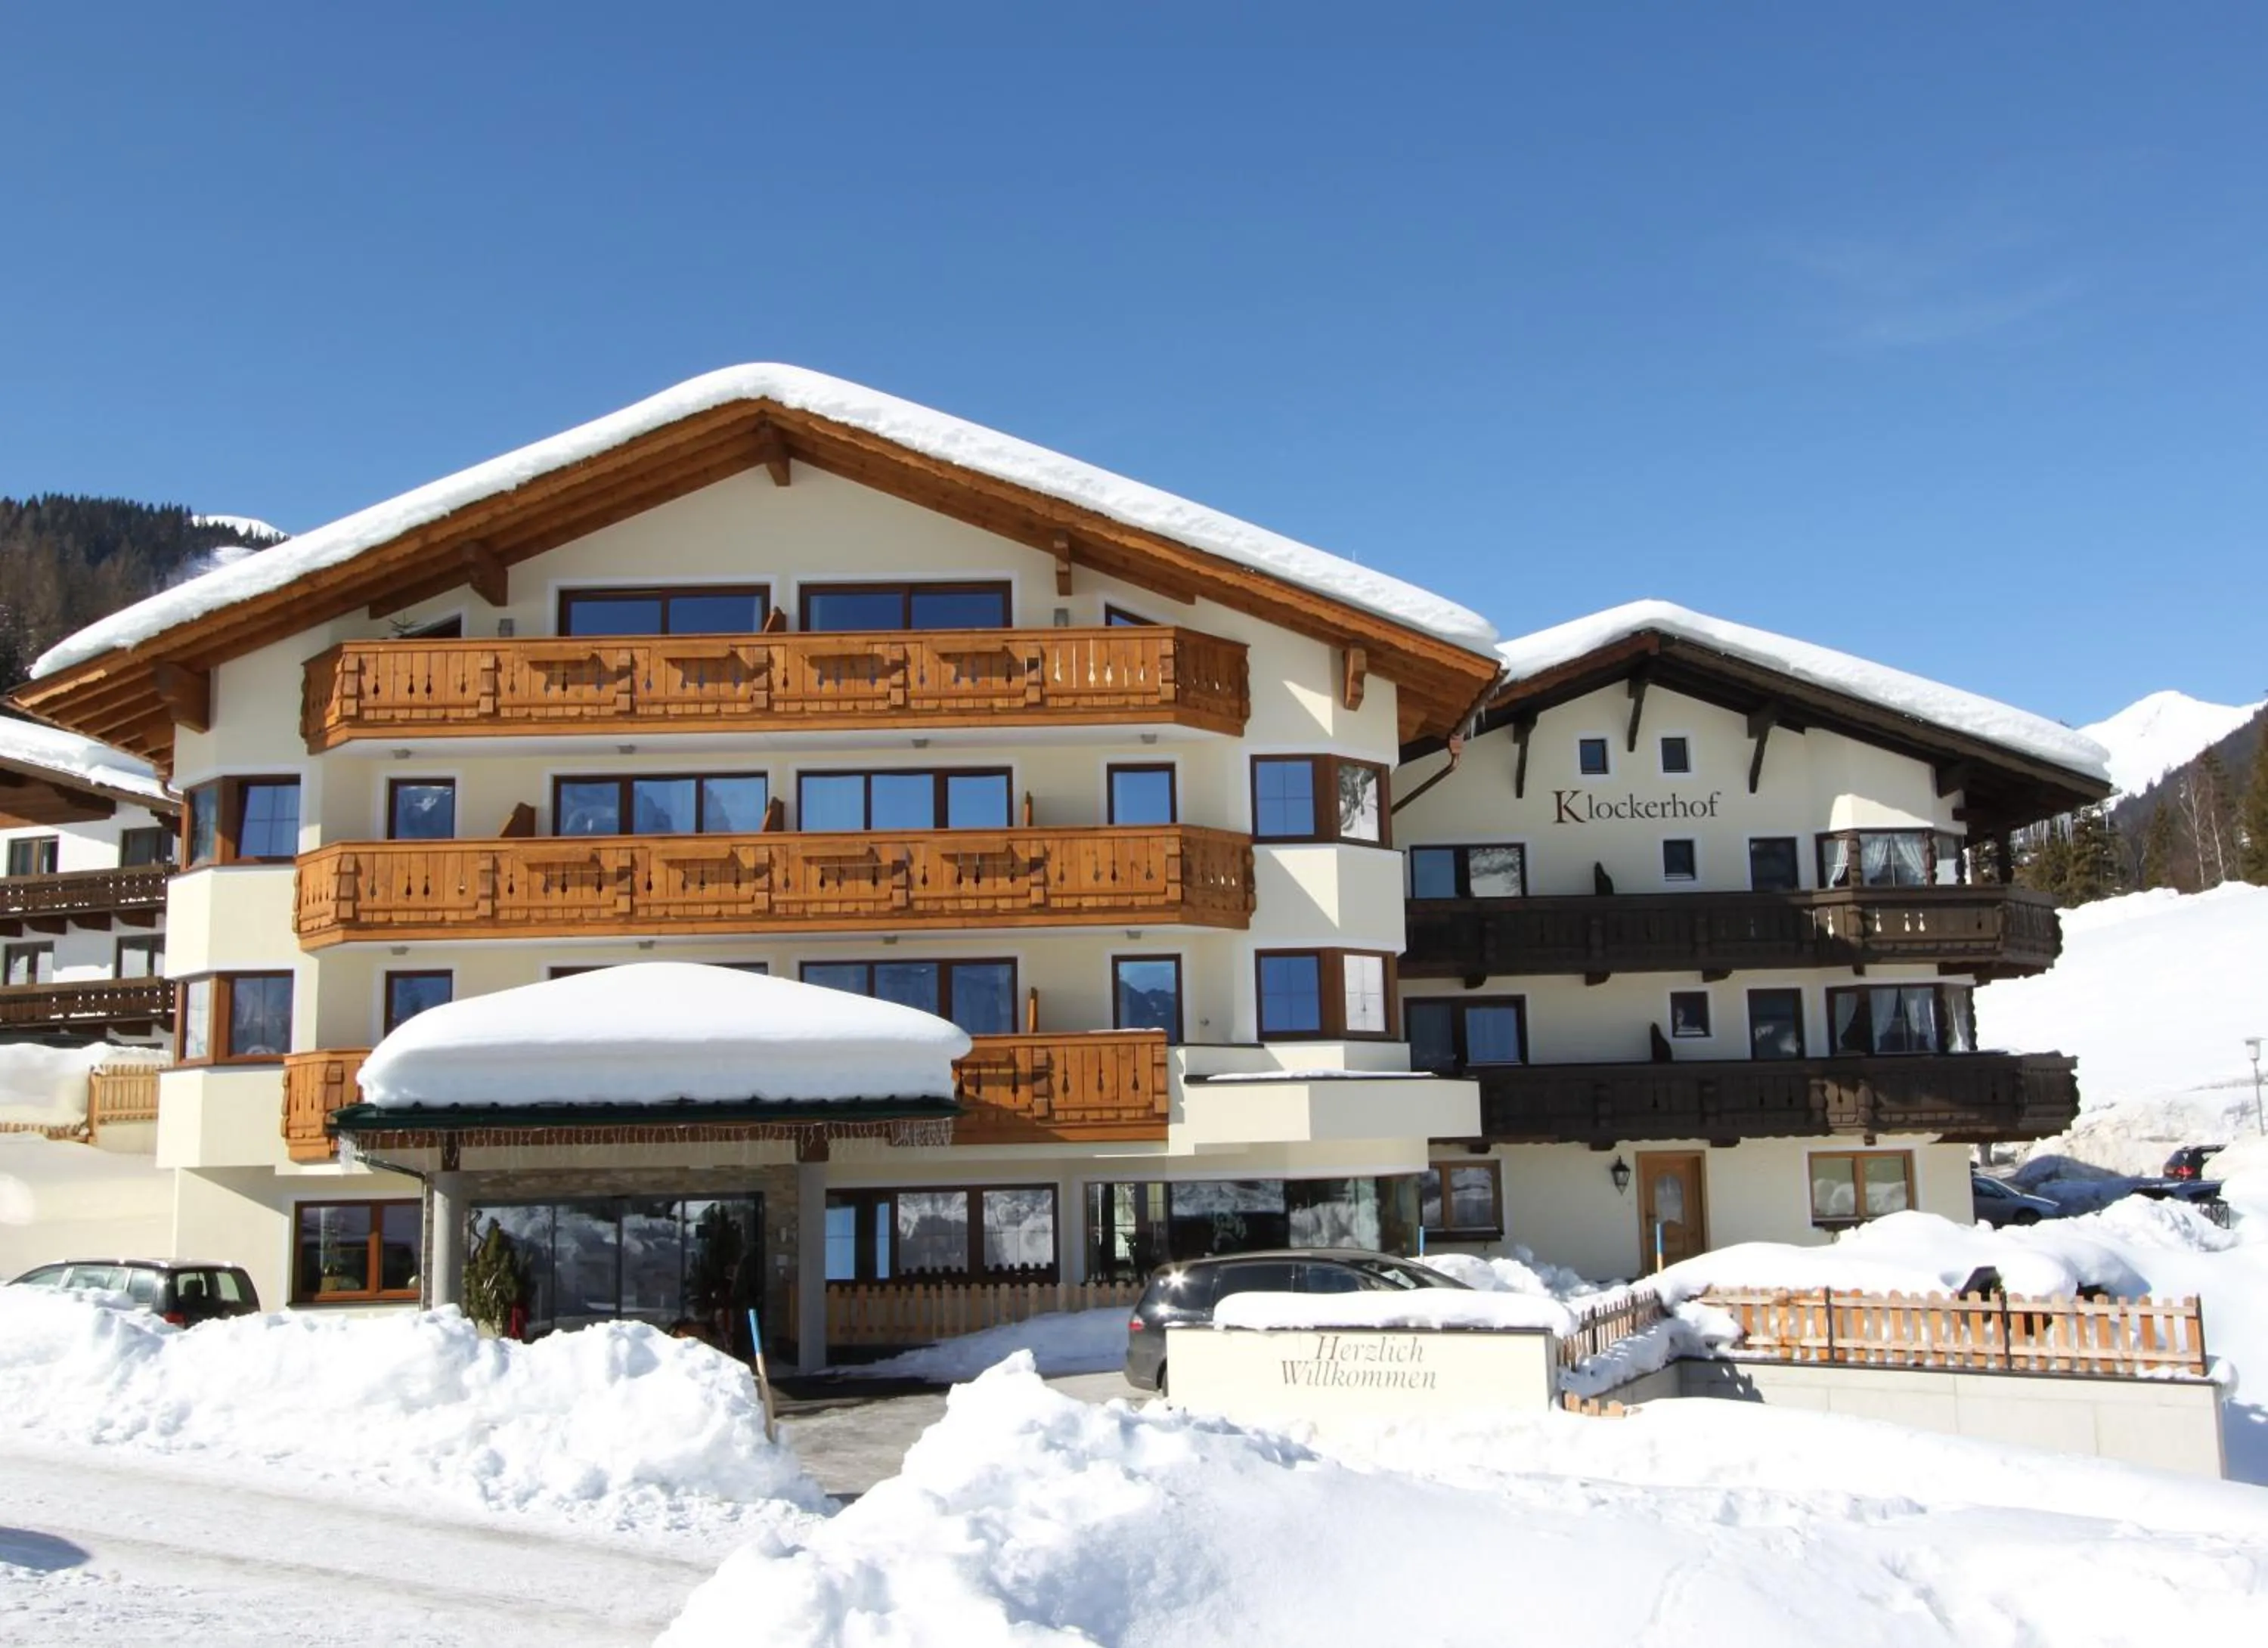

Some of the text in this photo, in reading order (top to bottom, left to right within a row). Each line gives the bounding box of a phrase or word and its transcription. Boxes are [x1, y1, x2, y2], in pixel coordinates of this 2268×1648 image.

[1553, 790, 1721, 824] Klockerhof
[1315, 1335, 1424, 1363] Herzlich
[1281, 1360, 1437, 1390] Willkommen
